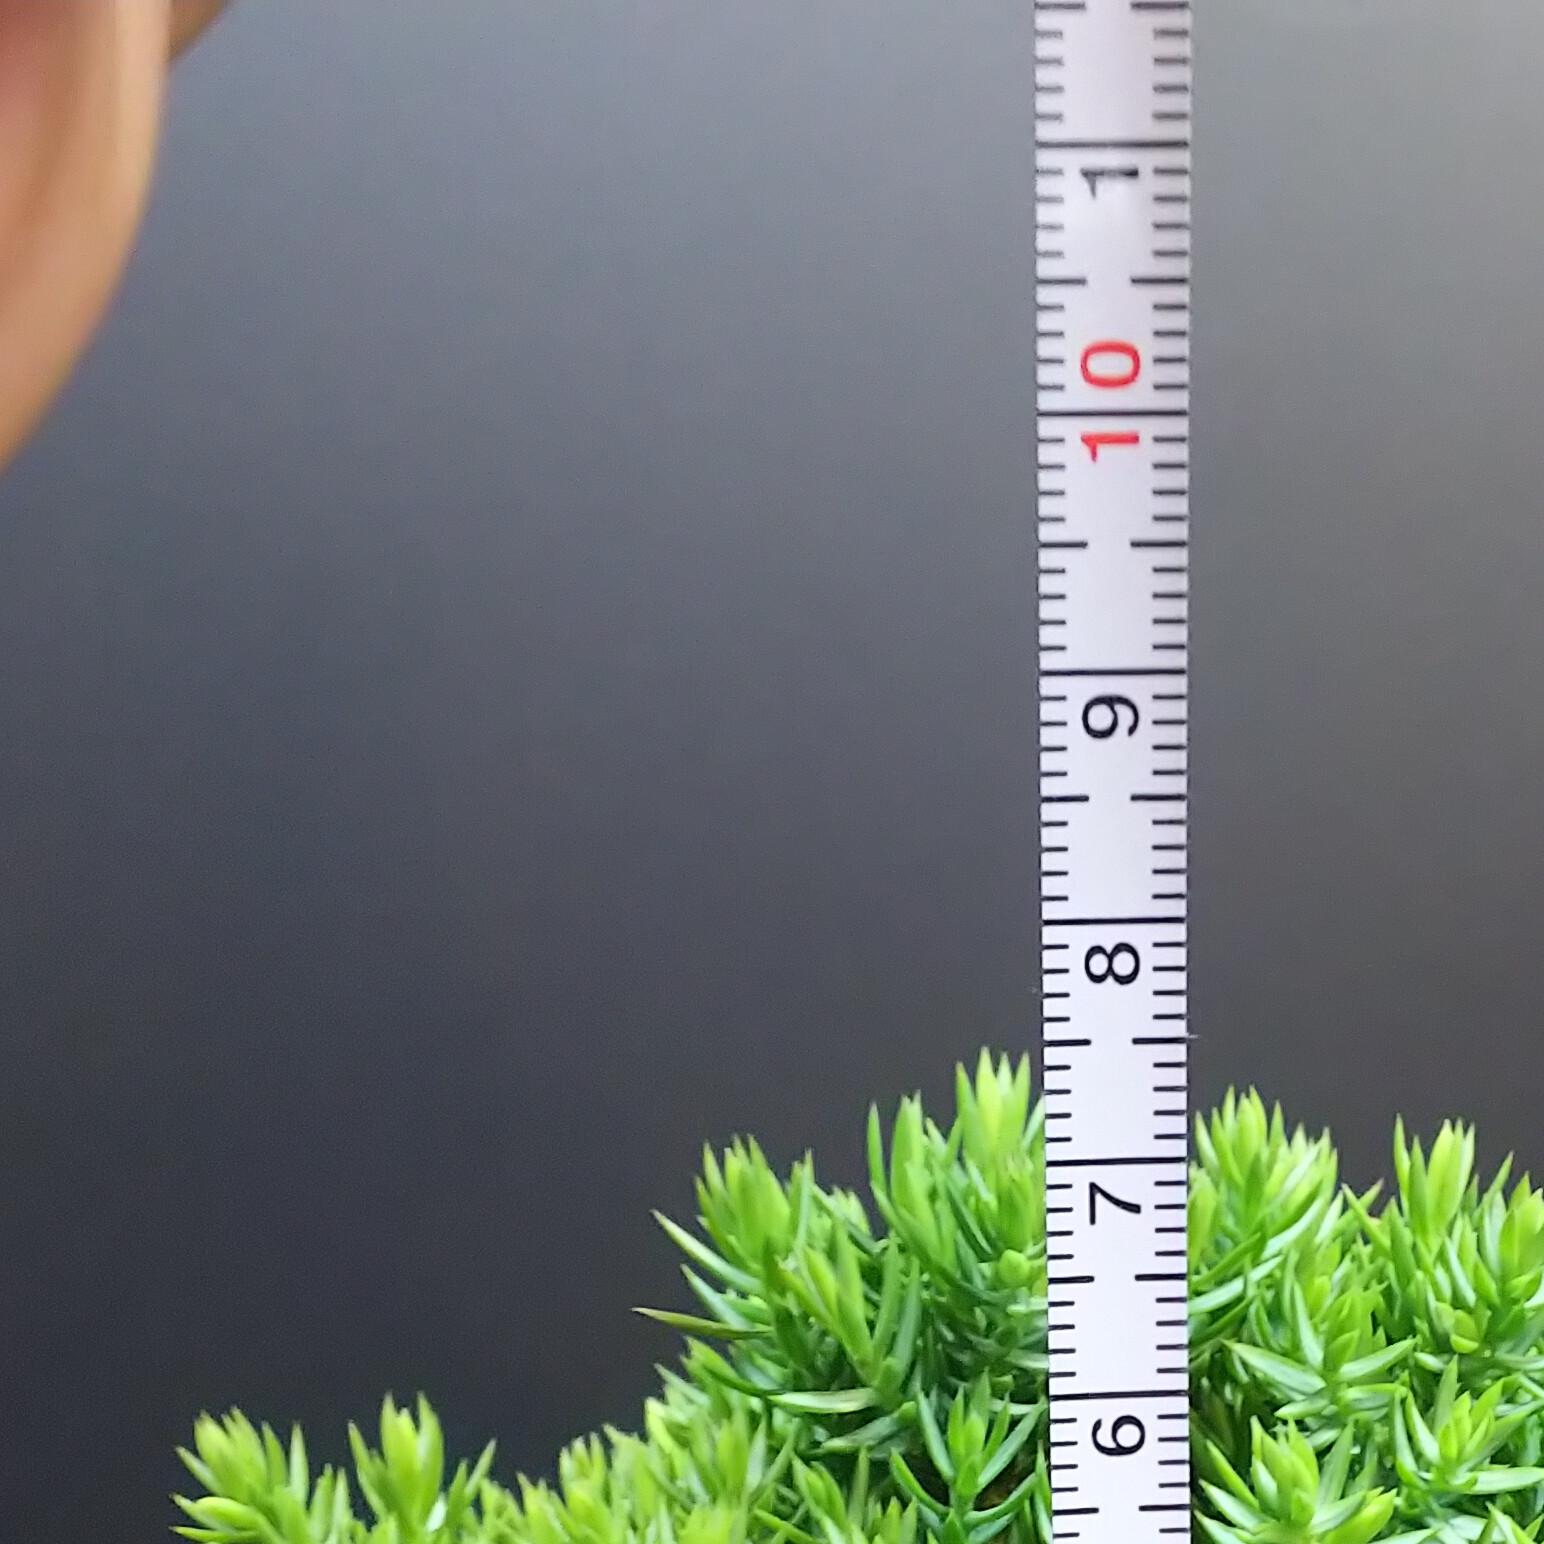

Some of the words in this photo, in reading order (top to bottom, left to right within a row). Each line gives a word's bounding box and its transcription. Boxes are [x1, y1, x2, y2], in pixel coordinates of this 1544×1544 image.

[1081, 340, 1141, 462] 10
[1082, 695, 1139, 738] 9
[1084, 943, 1140, 985] 8
[1089, 1182, 1142, 1225] 7
[1091, 1415, 1145, 1456] 6
